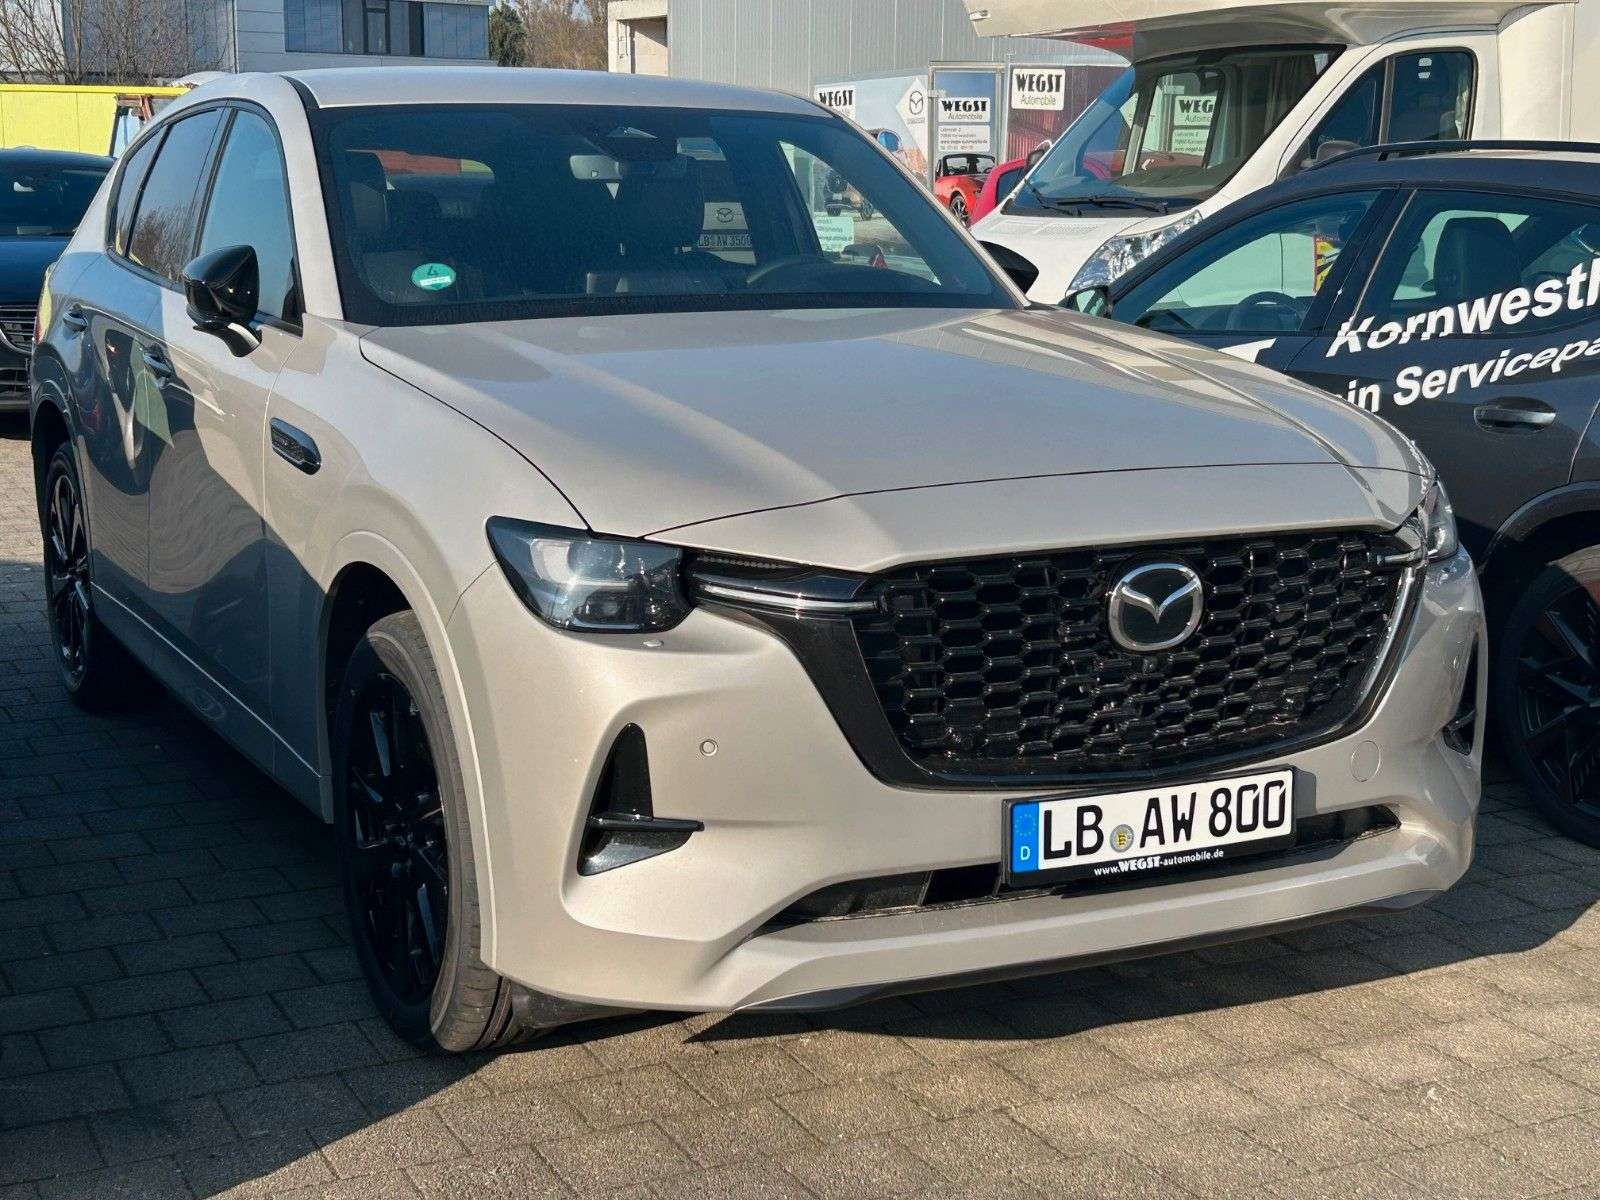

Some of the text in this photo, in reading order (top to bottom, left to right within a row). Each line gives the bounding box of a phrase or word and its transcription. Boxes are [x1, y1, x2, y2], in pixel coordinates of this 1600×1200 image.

[1015, 73, 1062, 93] WEGST
[818, 89, 853, 107] WEGST
[941, 100, 987, 112] WEGST
[1021, 94, 1056, 105] Automobile
[1178, 99, 1213, 113] WEG
[1185, 114, 1211, 122] Automo
[1020, 779, 1286, 861] D LB AW 800
[1094, 849, 1224, 876] www.WEGST-automobile.de
